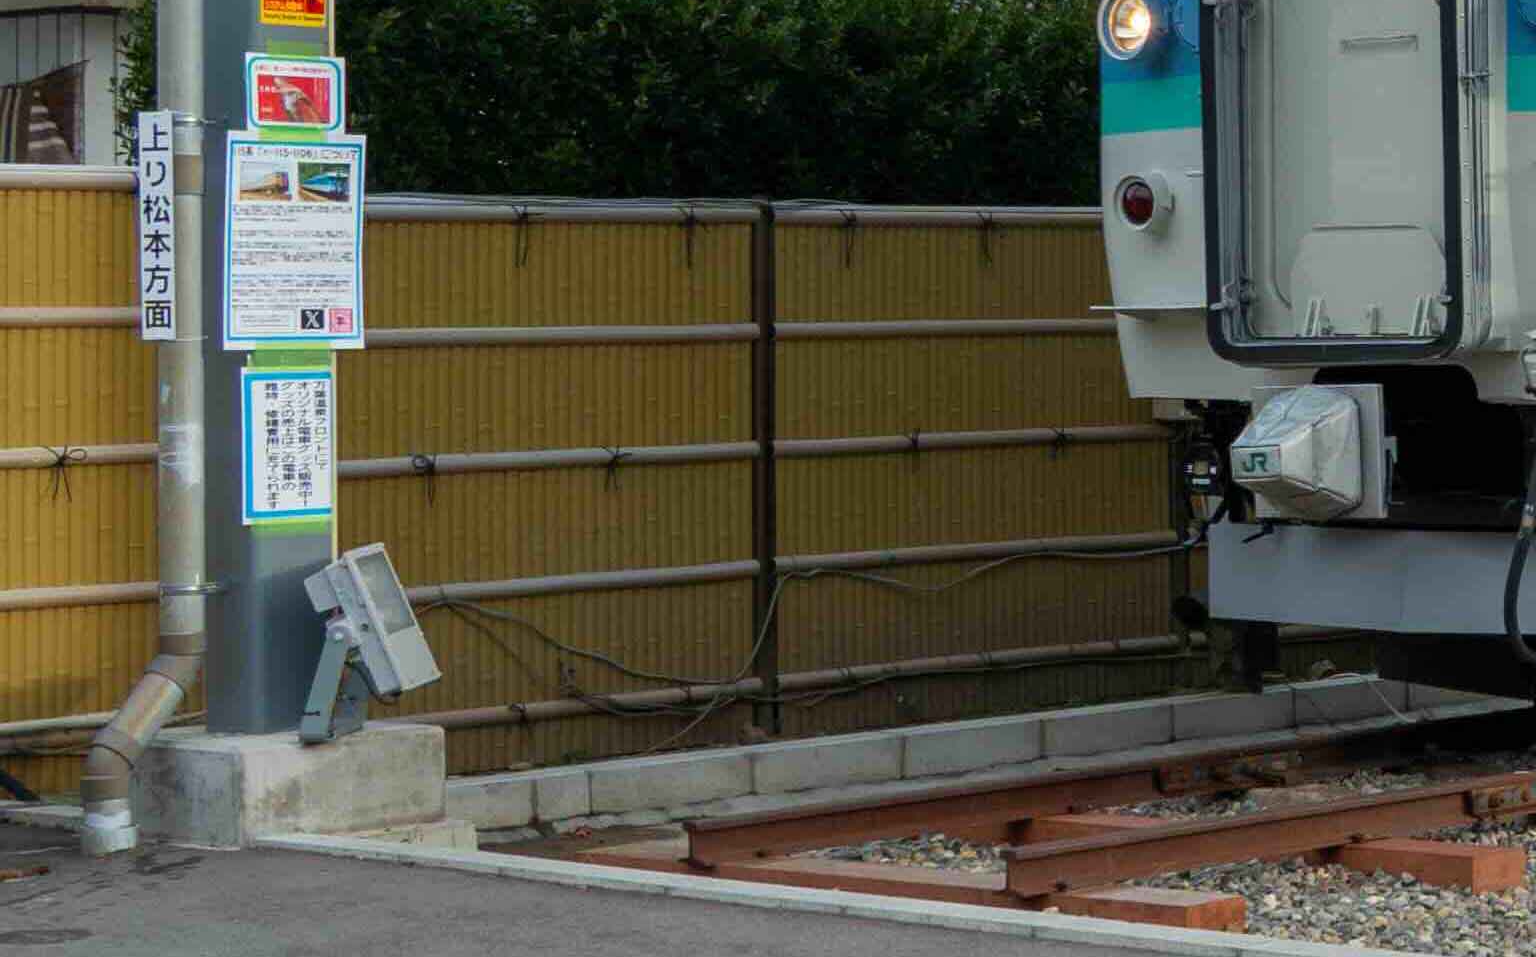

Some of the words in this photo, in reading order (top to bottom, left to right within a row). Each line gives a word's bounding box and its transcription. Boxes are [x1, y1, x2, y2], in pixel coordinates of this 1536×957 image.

[141, 123, 172, 330] 上り松本方面
[1240, 452, 1268, 472] JR
